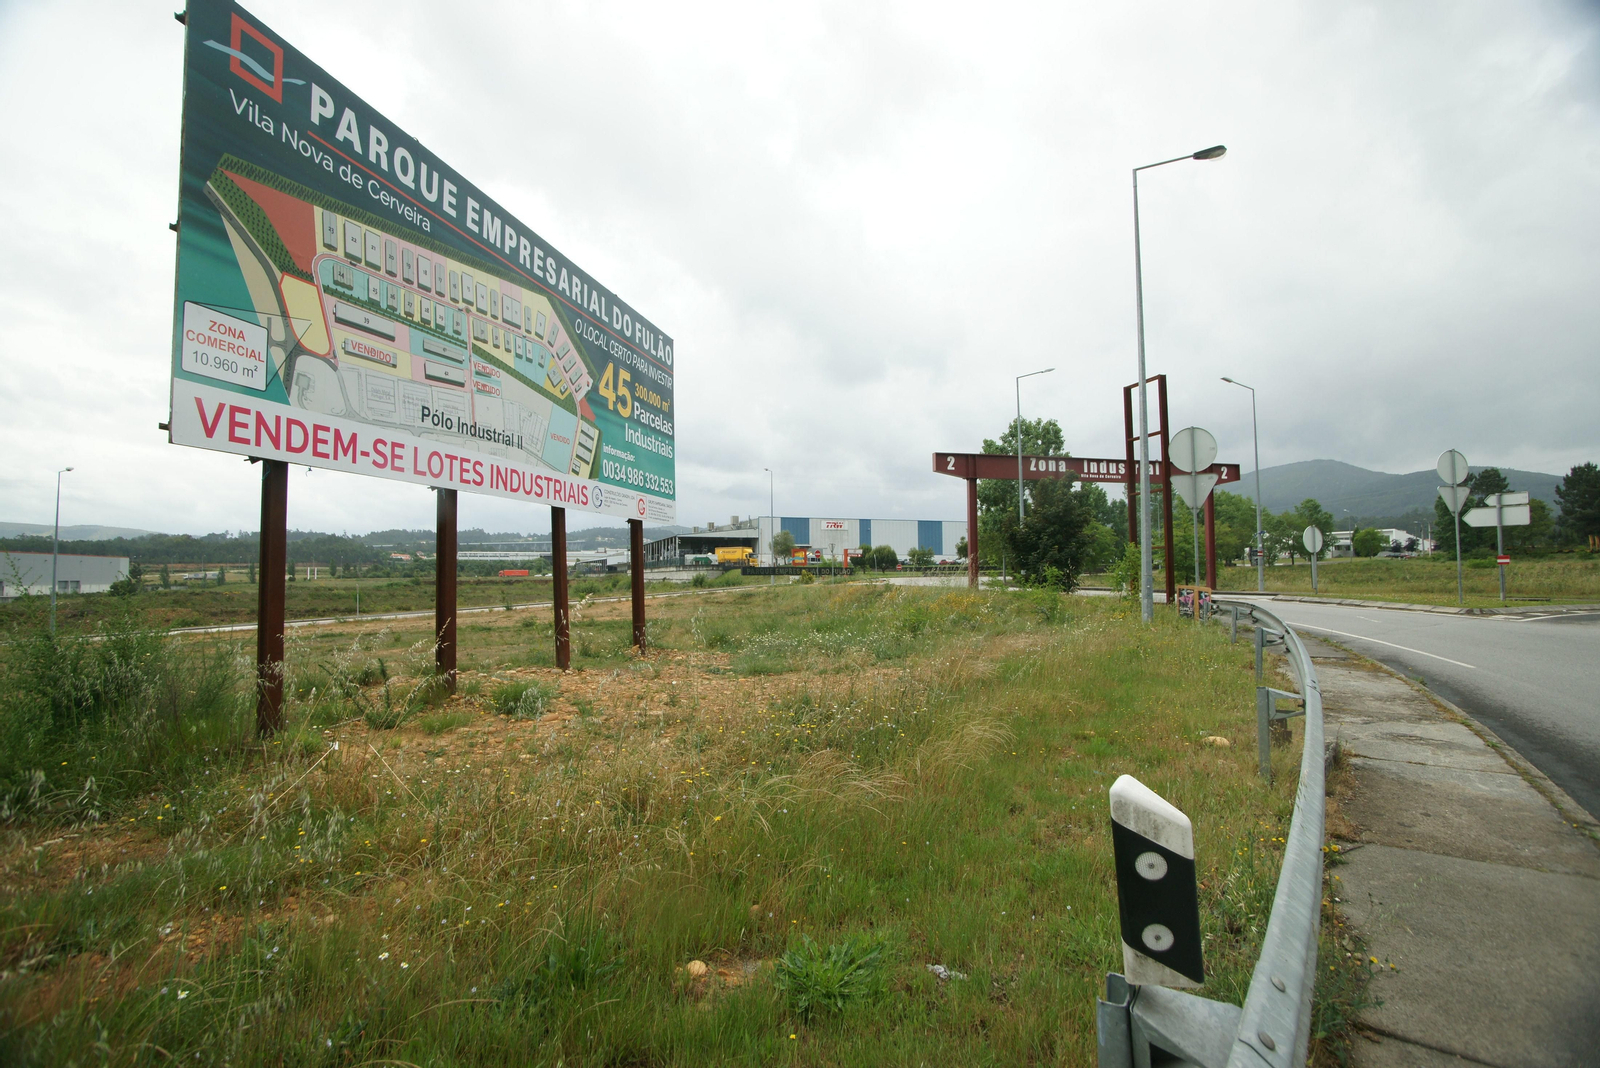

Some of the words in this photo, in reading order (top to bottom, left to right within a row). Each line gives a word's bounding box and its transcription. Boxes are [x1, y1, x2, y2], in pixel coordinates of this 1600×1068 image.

[229, 88, 274, 136] Vila
[282, 122, 334, 174] Nova
[339, 164, 363, 189] de
[368, 180, 431, 233] Cerveira
[310, 82, 458, 218] PARQUE
[466, 196, 609, 322] EMPRESARIAL
[612, 304, 632, 337] DO
[635, 322, 673, 366] FULÃO
[328, 226, 334, 234] 23
[208, 320, 246, 342] ZONA
[186, 330, 265, 363] COMERCIAL
[351, 340, 392, 363] VENDIDO
[575, 319, 582, 334] O
[583, 322, 608, 350] LOCAL
[610, 342, 632, 364] CERTO
[632, 352, 648, 374] PARA
[648, 362, 672, 389] INVESTIR
[193, 350, 238, 374] 10.960
[242, 365, 258, 378] m²
[473, 360, 500, 378] VENDIDO
[472, 380, 500, 396] VENDIDO
[599, 362, 632, 418] 45
[635, 383, 661, 408] 300.000
[421, 406, 453, 430] Pólo
[458, 417, 513, 447] Industrial
[518, 435, 523, 450] II
[634, 401, 673, 436] Parcelas
[194, 397, 405, 473] VENDEM-SE
[413, 446, 484, 486] LOTES
[490, 464, 588, 506] INDUSTRIAIS
[550, 433, 570, 445] VENDIDO
[625, 422, 673, 459] Industriais
[603, 443, 636, 462] informação:
[947, 456, 955, 470] 2
[1030, 458, 1066, 472] Zona
[603, 459, 626, 482] 0034
[627, 465, 644, 487] 986
[645, 470, 659, 492] 332
[660, 476, 674, 495] 553
[1221, 466, 1228, 479] 2
